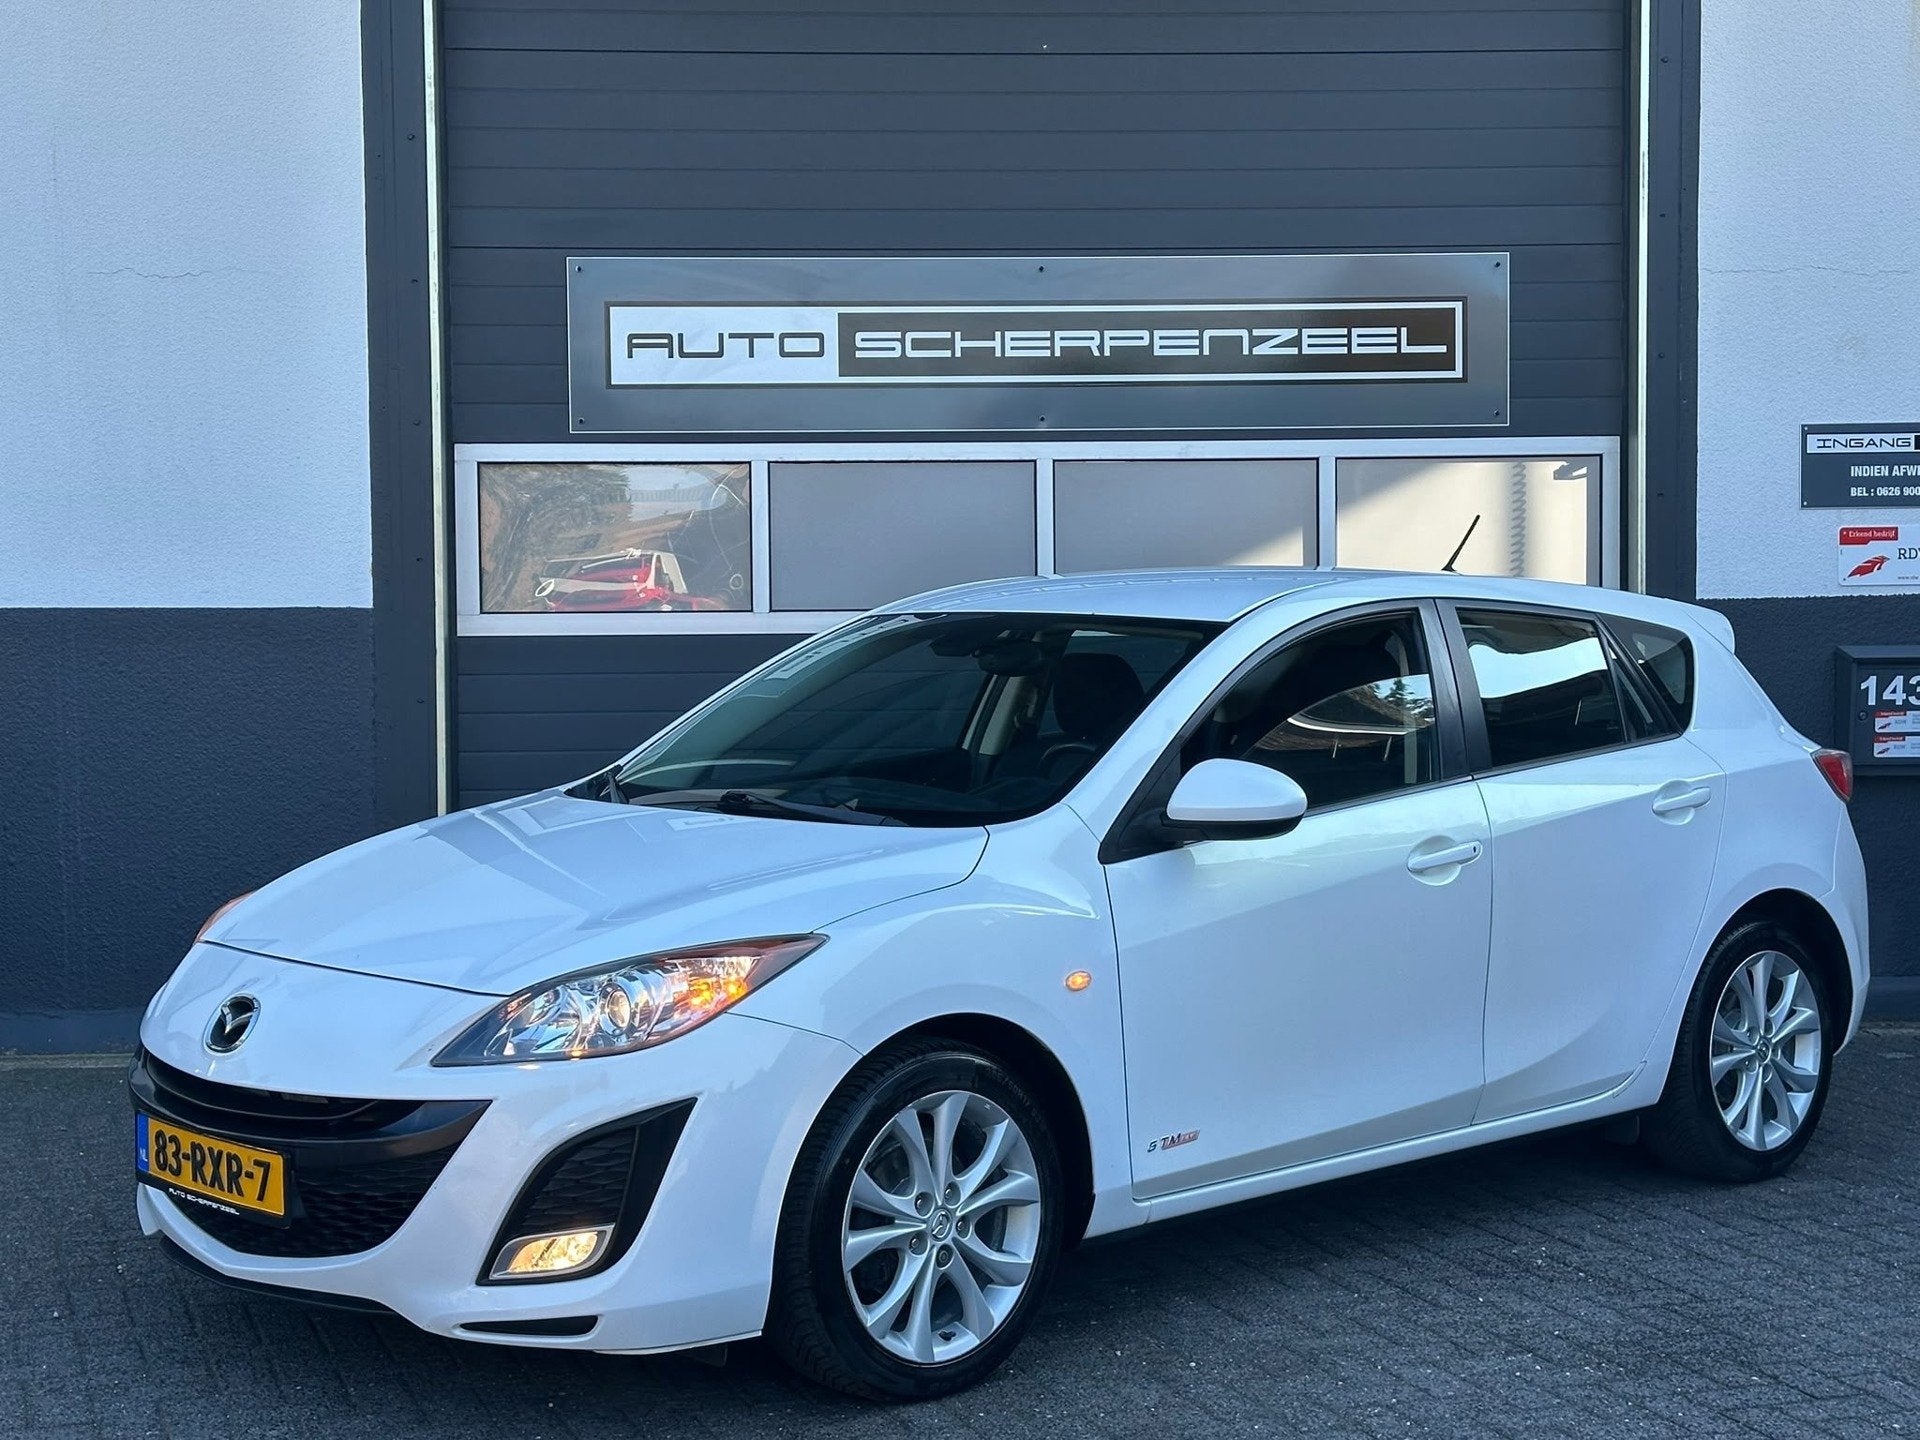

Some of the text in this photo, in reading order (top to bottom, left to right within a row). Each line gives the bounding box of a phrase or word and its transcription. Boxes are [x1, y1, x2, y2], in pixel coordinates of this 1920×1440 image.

[627, 326, 1447, 359] AUTO SCHERPENZEEL
[1817, 437, 1911, 449] INGANG
[1850, 465, 1889, 477] INDIEN
[1850, 487, 1869, 497] BEL
[1876, 486, 1901, 497] 0626
[1903, 486, 1920, 496] 900
[1897, 547, 1920, 560] RD
[1861, 675, 1920, 706] 143
[154, 1129, 271, 1202] 83-RXR-7
[168, 1187, 186, 1198] AUTO
